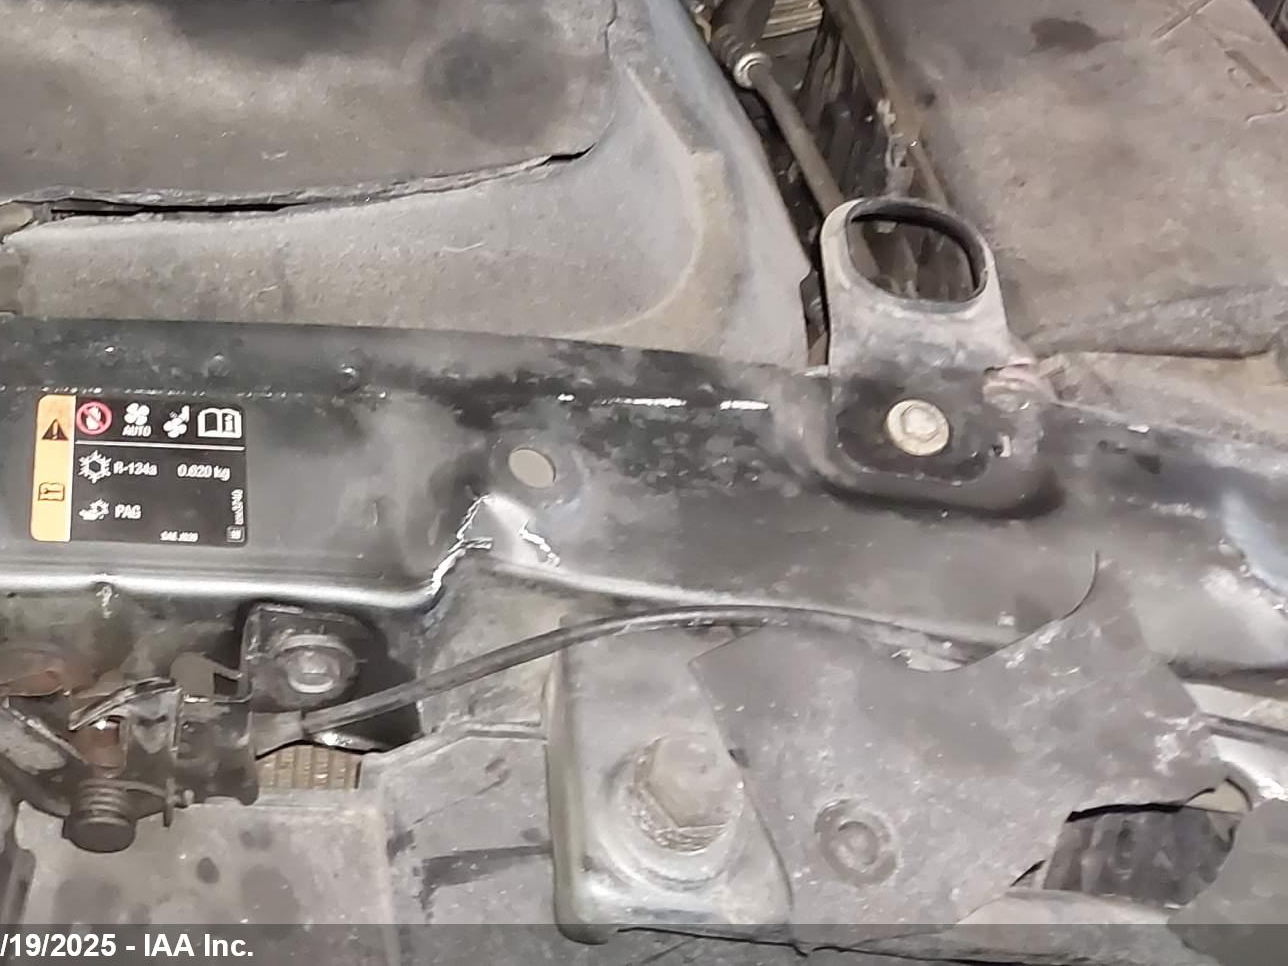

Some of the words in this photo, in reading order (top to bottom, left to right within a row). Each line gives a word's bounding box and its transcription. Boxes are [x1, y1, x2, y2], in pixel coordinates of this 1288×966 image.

[122, 424, 152, 437] AUTO
[213, 466, 231, 481] kg
[114, 504, 142, 519] PAG
